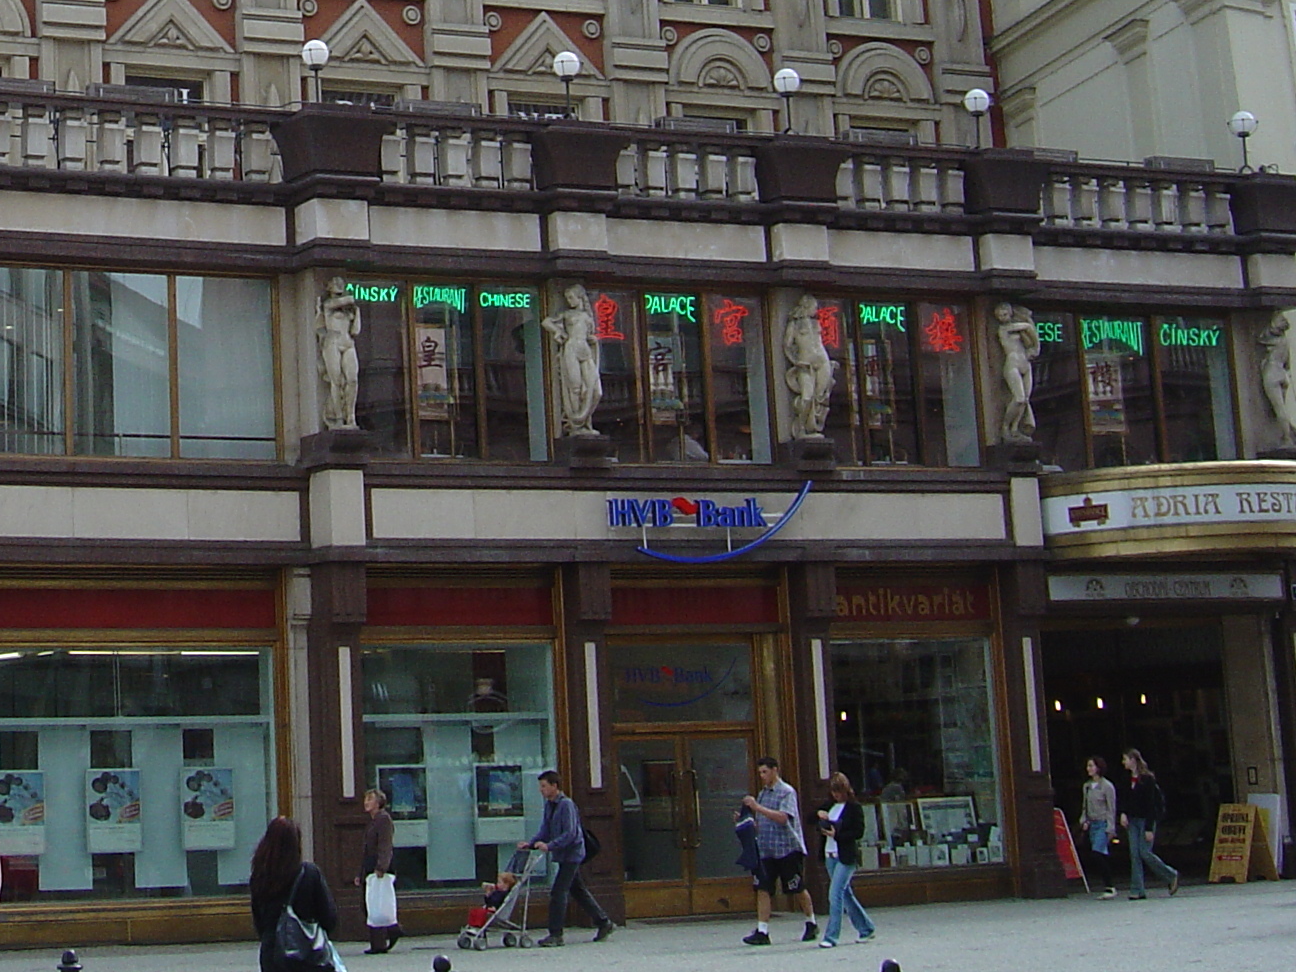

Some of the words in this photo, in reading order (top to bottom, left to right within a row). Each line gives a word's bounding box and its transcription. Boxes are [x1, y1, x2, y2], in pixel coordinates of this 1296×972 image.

[346, 283, 398, 302] ÍNSKÝ
[413, 285, 467, 313] RESTAURANT
[479, 292, 531, 308] CHINESE
[644, 294, 696, 323] PALACE
[859, 304, 906, 332] PALACE
[1080, 319, 1143, 356] RESTAURANT
[1160, 323, 1220, 346] ČÍNSKÝ
[606, 498, 674, 527] HVB
[693, 497, 768, 527] Bank
[1131, 493, 1222, 519] ADRIA
[1235, 492, 1296, 515] REST
[672, 666, 713, 683] Bank
